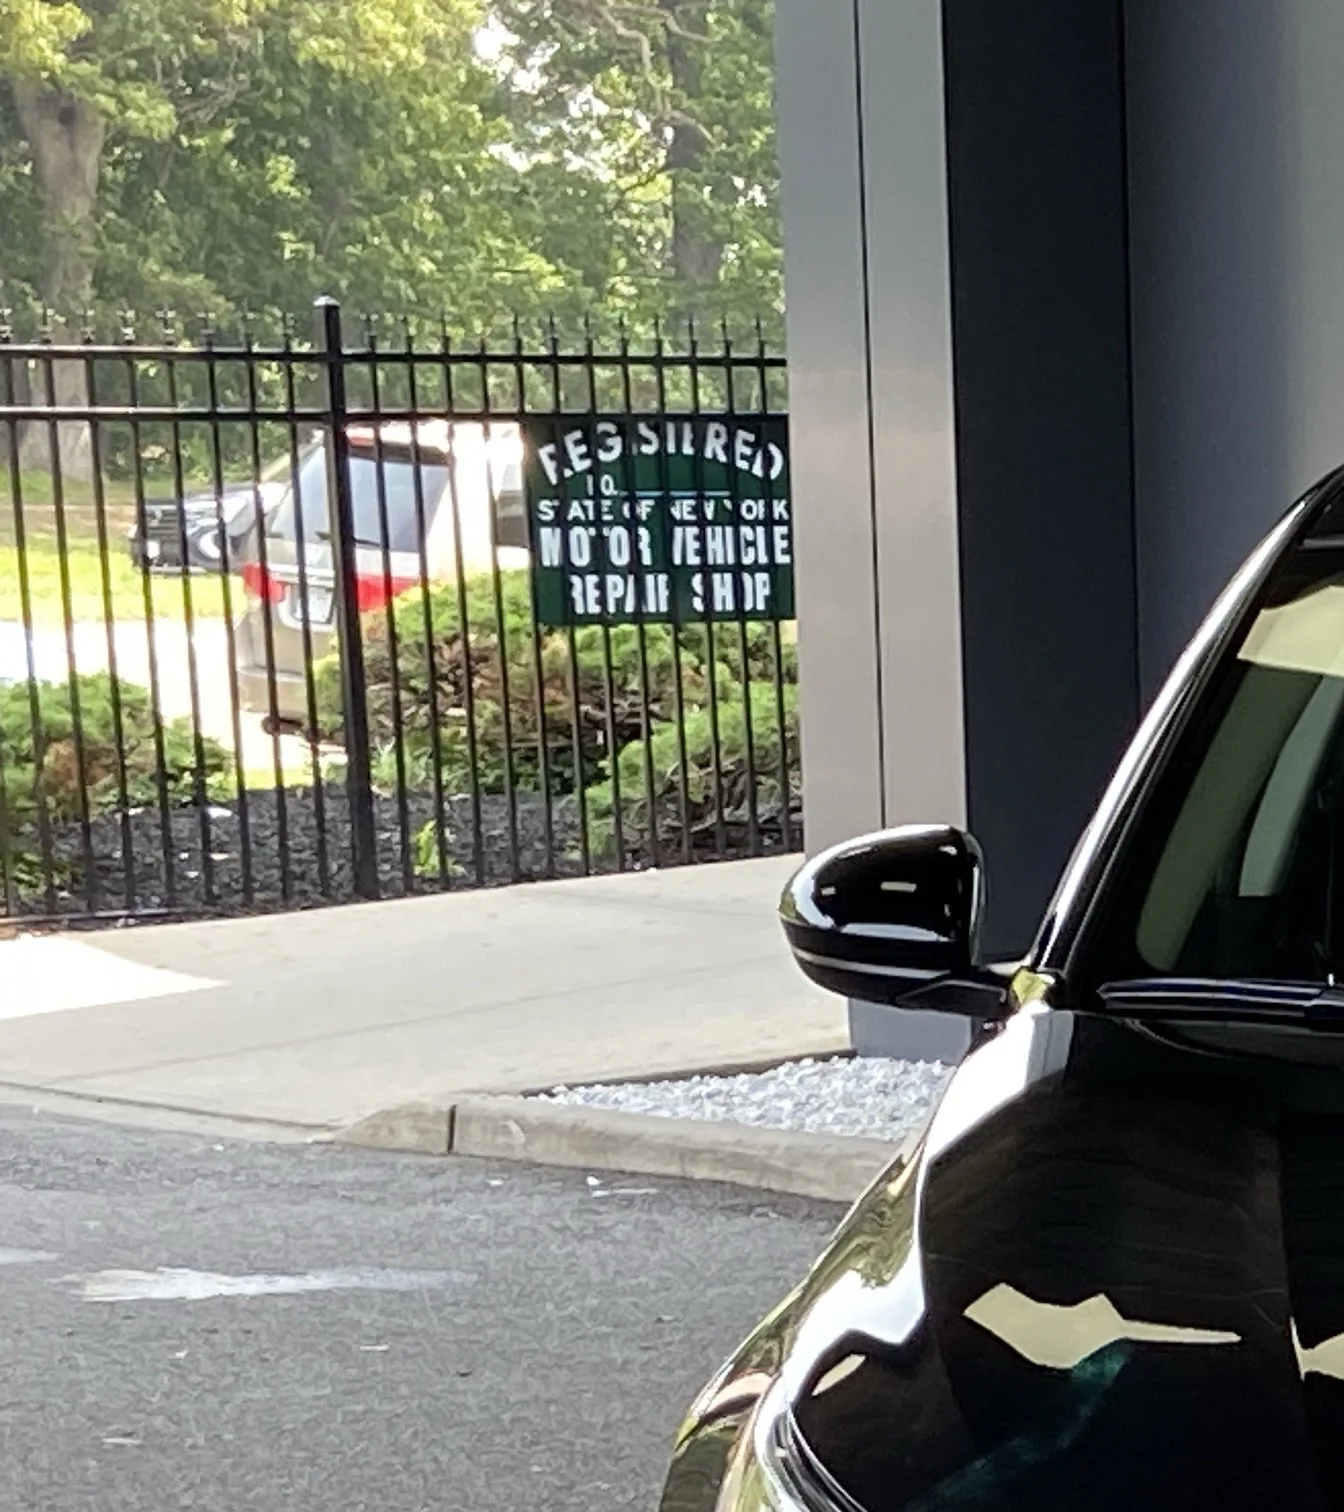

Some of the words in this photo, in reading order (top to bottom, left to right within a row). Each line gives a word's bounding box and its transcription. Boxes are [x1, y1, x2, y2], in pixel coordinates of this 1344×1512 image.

[537, 421, 784, 487] REGSERED
[538, 498, 614, 521] SATE
[721, 498, 790, 521] OK
[539, 526, 653, 567] MOOR
